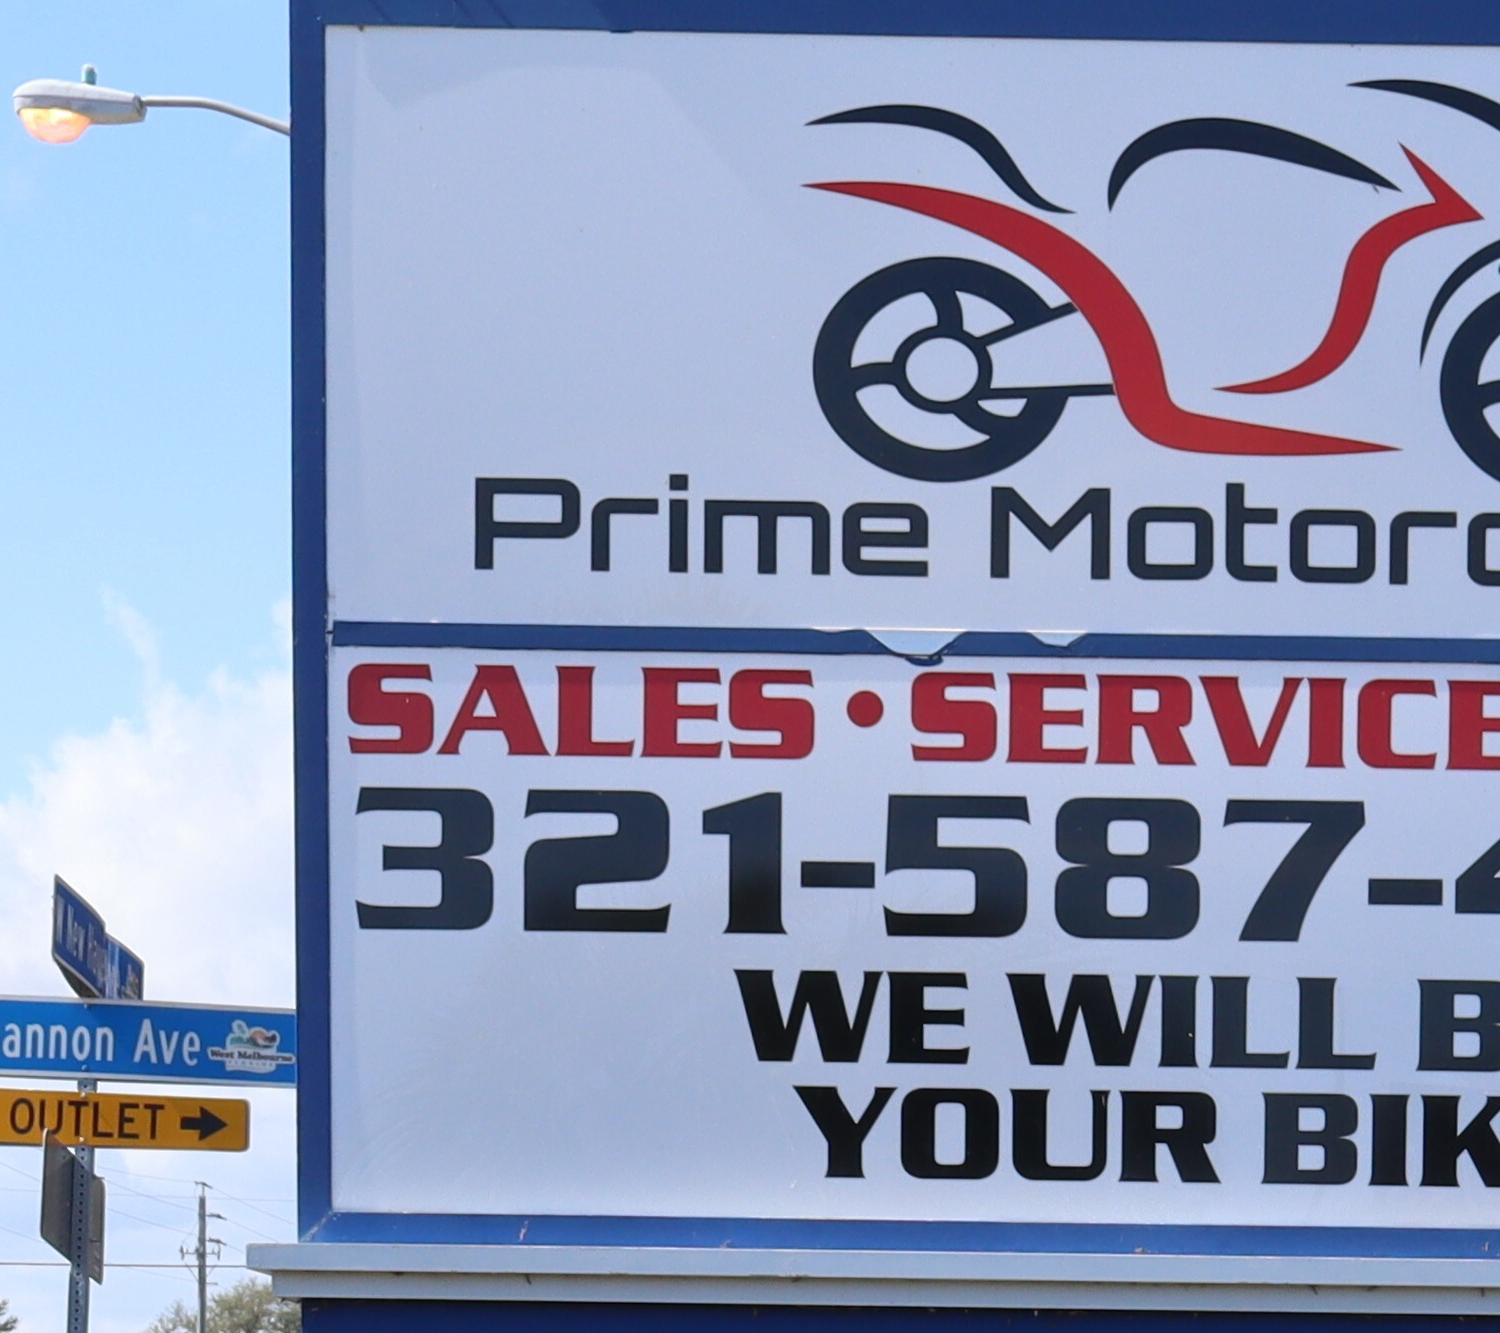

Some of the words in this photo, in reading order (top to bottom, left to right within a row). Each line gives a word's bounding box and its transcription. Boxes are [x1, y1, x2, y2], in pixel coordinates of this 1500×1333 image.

[475, 475, 930, 577] Prime
[347, 663, 814, 758] SALES
[134, 1018, 201, 1067] Ave
[734, 969, 970, 1067] WE
[1006, 973, 1376, 1071] WILL
[9, 1097, 166, 1141] OUTLET
[793, 1086, 1220, 1185] YOUR
